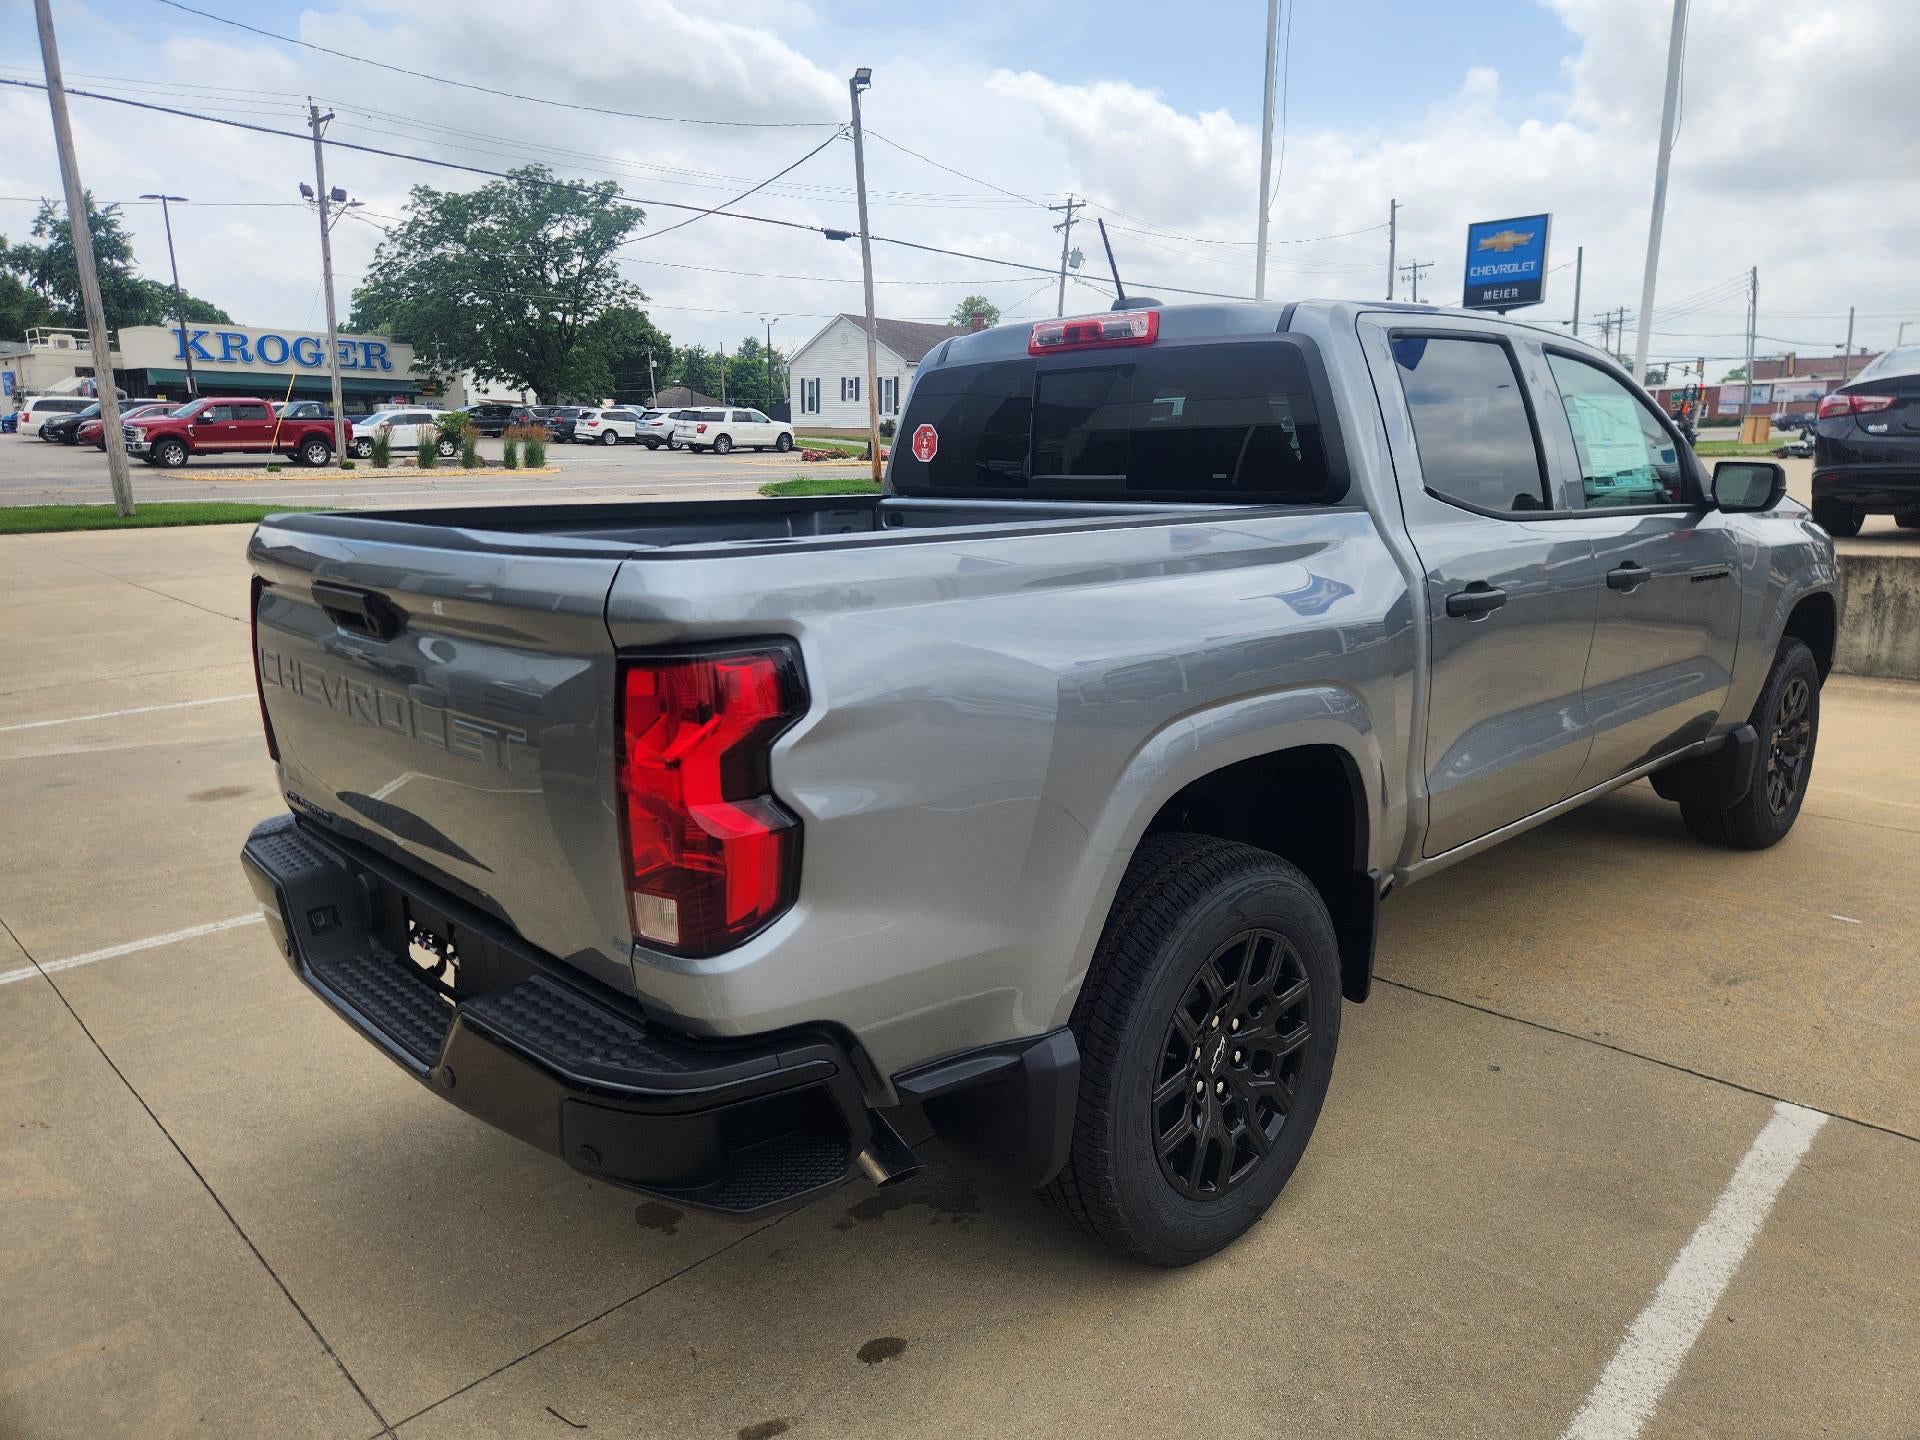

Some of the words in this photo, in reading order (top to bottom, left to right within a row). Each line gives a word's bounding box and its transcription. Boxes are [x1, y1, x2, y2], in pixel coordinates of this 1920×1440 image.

[1470, 261, 1536, 277] CHEVROLET
[1483, 288, 1518, 300] MEIER
[172, 329, 393, 372] KROGER
[260, 646, 528, 770] CHEVROLET
